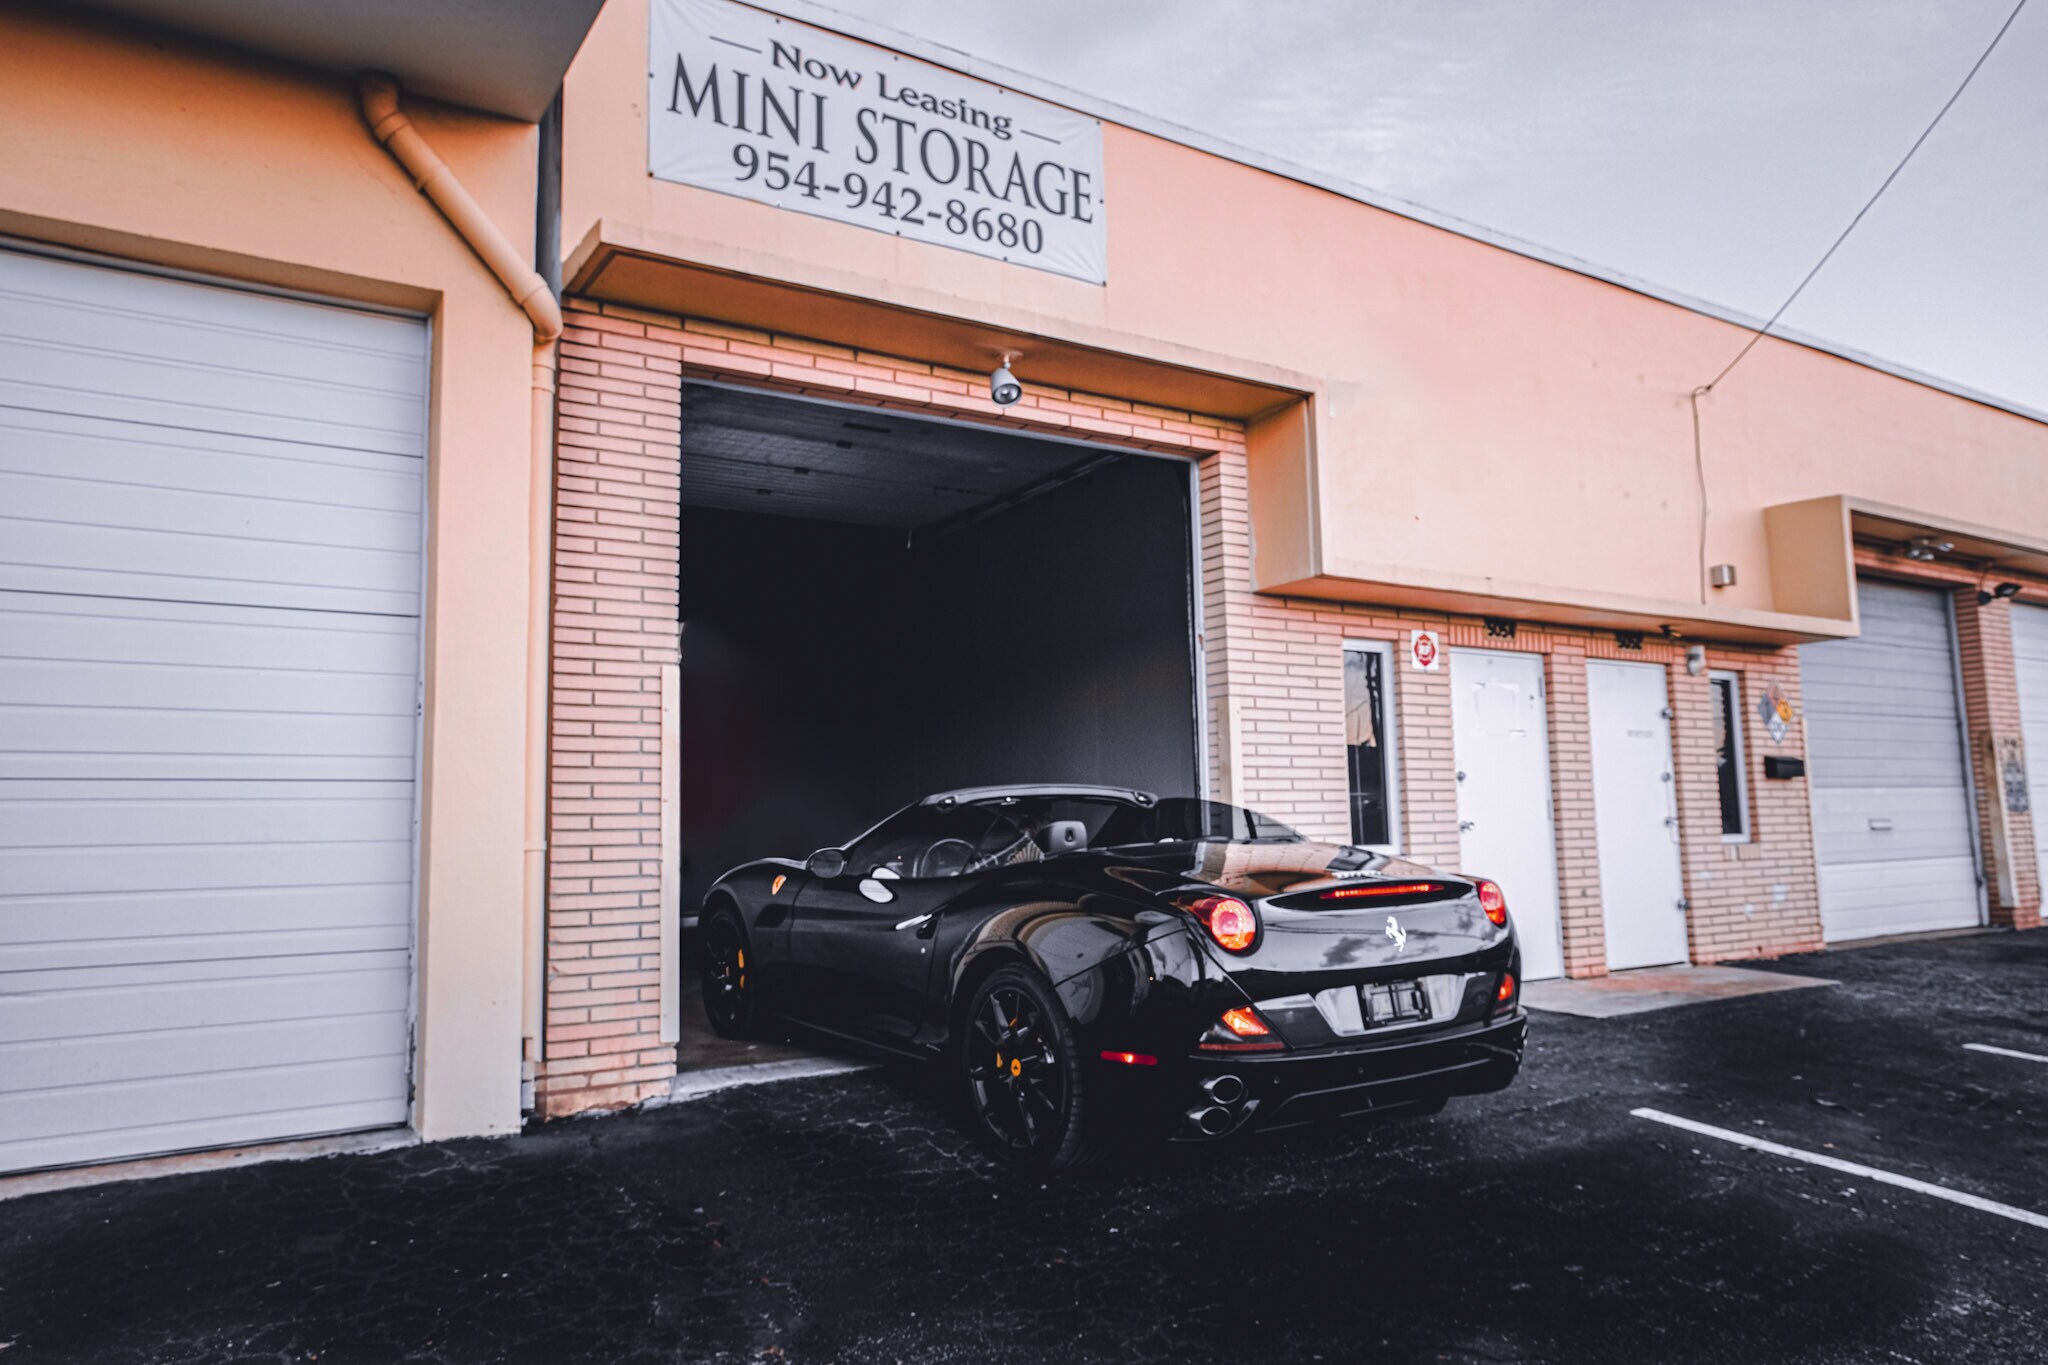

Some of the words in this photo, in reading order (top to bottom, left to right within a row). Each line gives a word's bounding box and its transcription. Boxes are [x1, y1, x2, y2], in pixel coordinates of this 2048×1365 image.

[666, 52, 829, 154] MINI
[855, 107, 1093, 224] STORAGE
[770, 39, 863, 90] Now
[877, 72, 1013, 141] Leasing
[732, 143, 1043, 254] 954-942-8680
